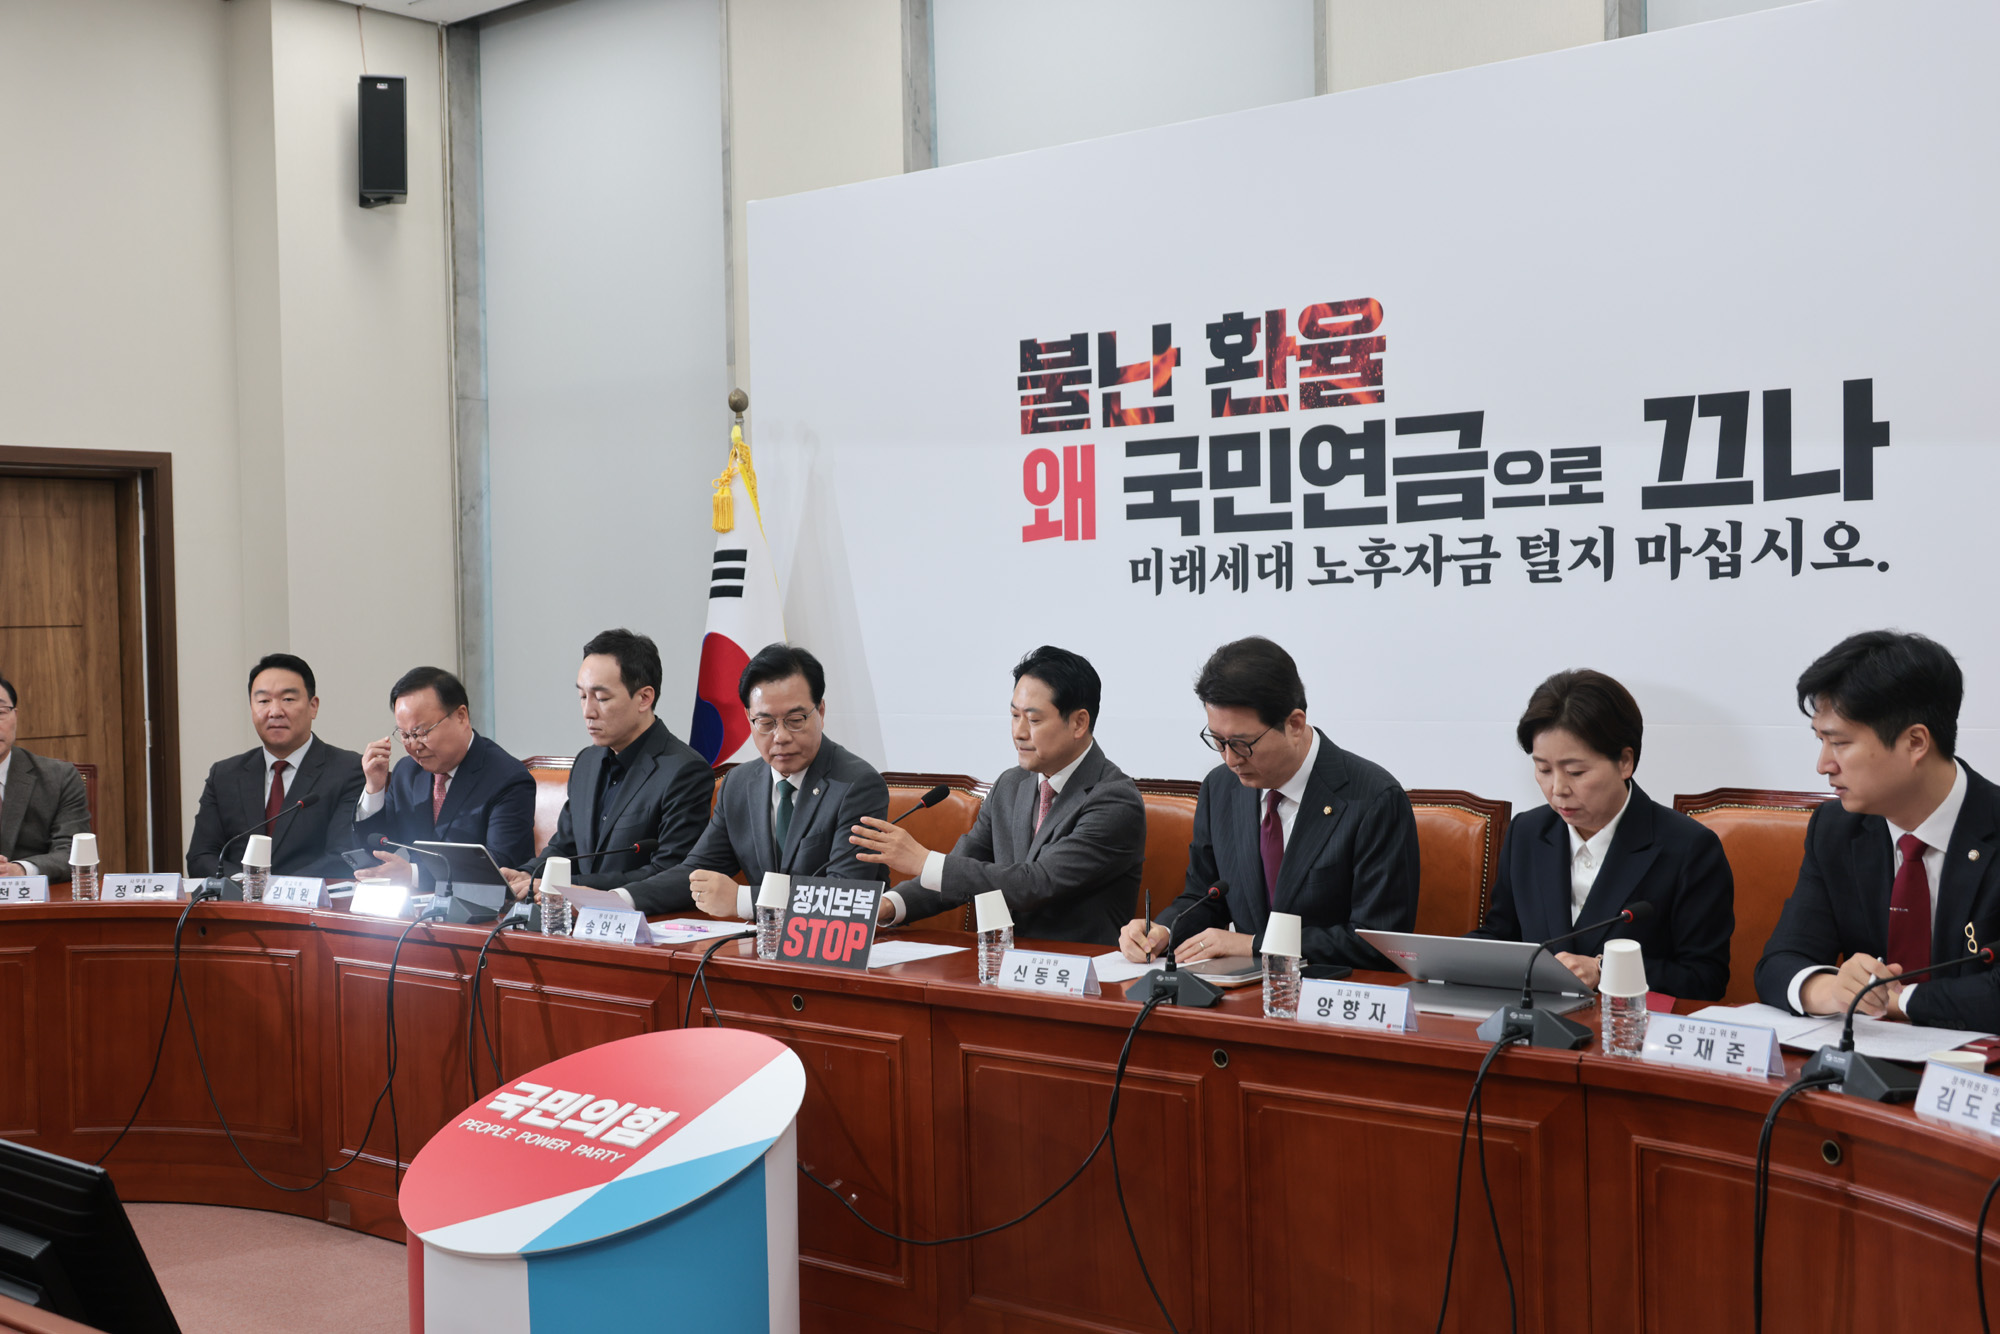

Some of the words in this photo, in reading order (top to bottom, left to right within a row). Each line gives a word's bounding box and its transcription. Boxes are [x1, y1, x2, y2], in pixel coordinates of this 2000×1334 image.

[1018, 323, 1181, 435] 불난
[1206, 297, 1387, 418] 환율
[1022, 444, 1096, 543] 왜
[1123, 410, 1604, 537] 국민연금으로
[1641, 377, 1891, 510] 끄나
[1128, 540, 1293, 597] 미래세대
[1307, 533, 1502, 589] 노후자금
[1516, 525, 1615, 584] 털지
[1634, 516, 1890, 582] 마십시오.
[272, 886, 310, 902] 김재원
[792, 884, 875, 920] 정치보복
[585, 919, 626, 938] 송언석
[782, 916, 868, 962] STOP
[1013, 964, 1070, 988] 신동욱
[1316, 996, 1387, 1023] 양향자
[1664, 1033, 1746, 1066] 우재준
[486, 1081, 681, 1150] 국민의힘
[458, 1117, 517, 1140] PEOPLE
[514, 1130, 572, 1152] POWER
[571, 1143, 626, 1164] PARTY
